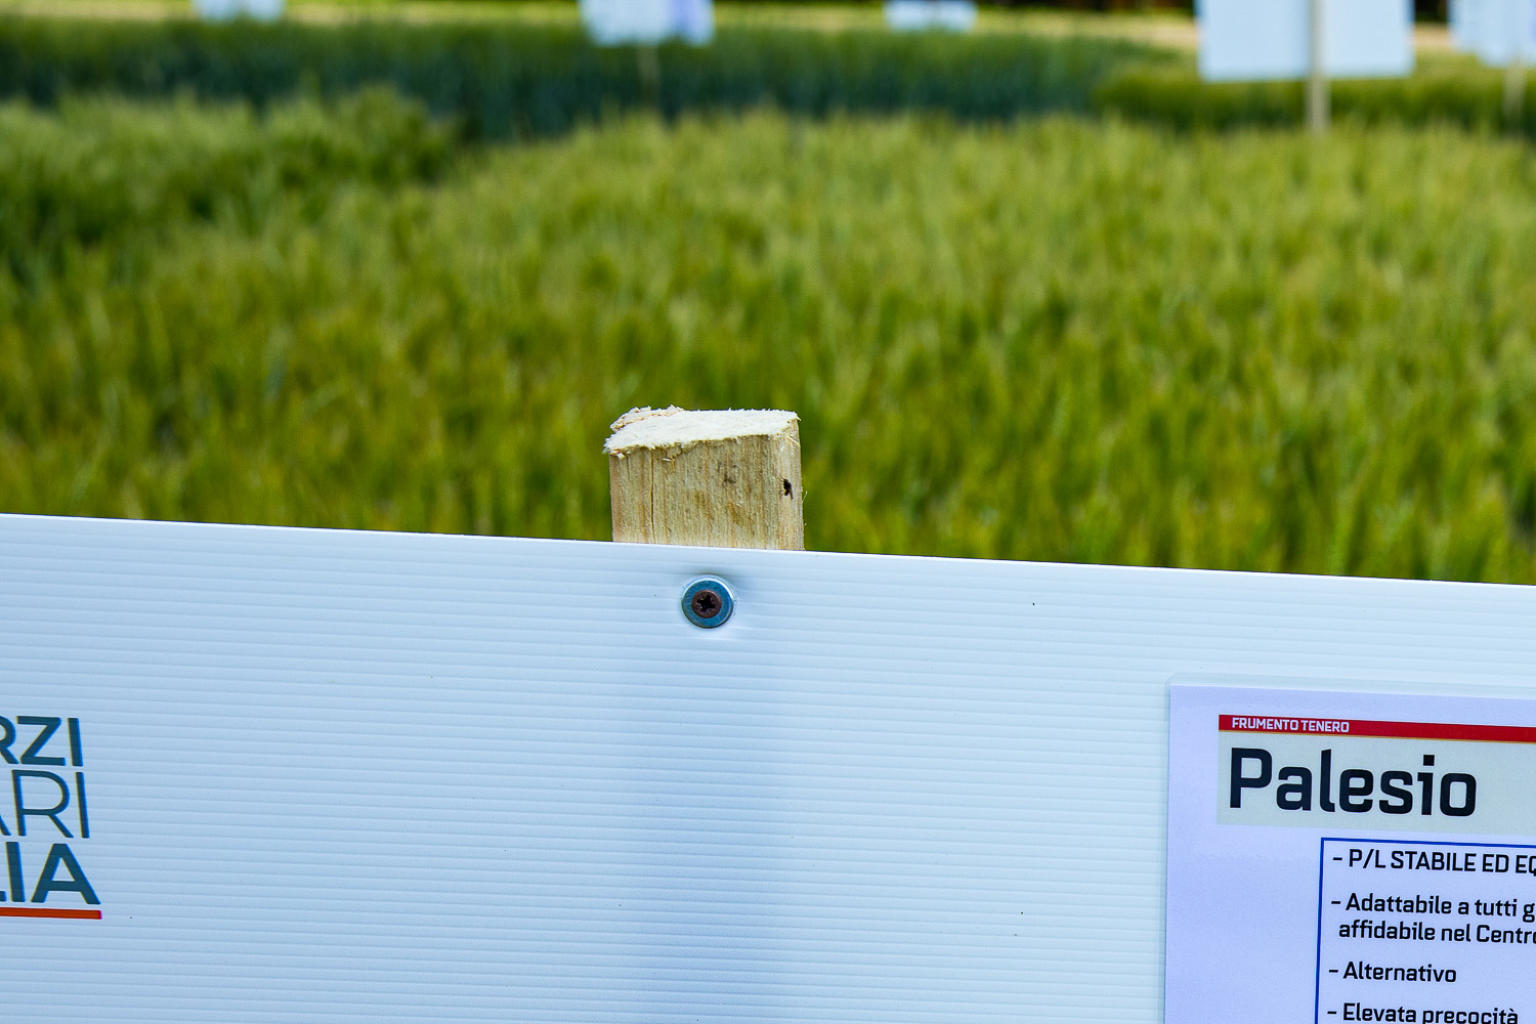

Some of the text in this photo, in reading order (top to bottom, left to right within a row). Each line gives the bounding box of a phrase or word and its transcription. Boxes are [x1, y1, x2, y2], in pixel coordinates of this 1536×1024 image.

[1231, 717, 1350, 733] FRUMENTO TENERO
[1229, 747, 1477, 817] Palesio
[0, 769, 90, 839] RI
[0, 841, 101, 905] IA
[1348, 848, 1387, 870] P/L
[1390, 850, 1477, 873] STABILE
[1481, 853, 1510, 874] ED
[1345, 892, 1452, 915] Adattabile
[1457, 899, 1470, 916] a
[1473, 895, 1518, 918] tutti
[1338, 919, 1436, 942] affidabile
[1440, 922, 1472, 943] nel
[1343, 961, 1457, 984] Alternativo
[1342, 1002, 1417, 1024] Elevata
